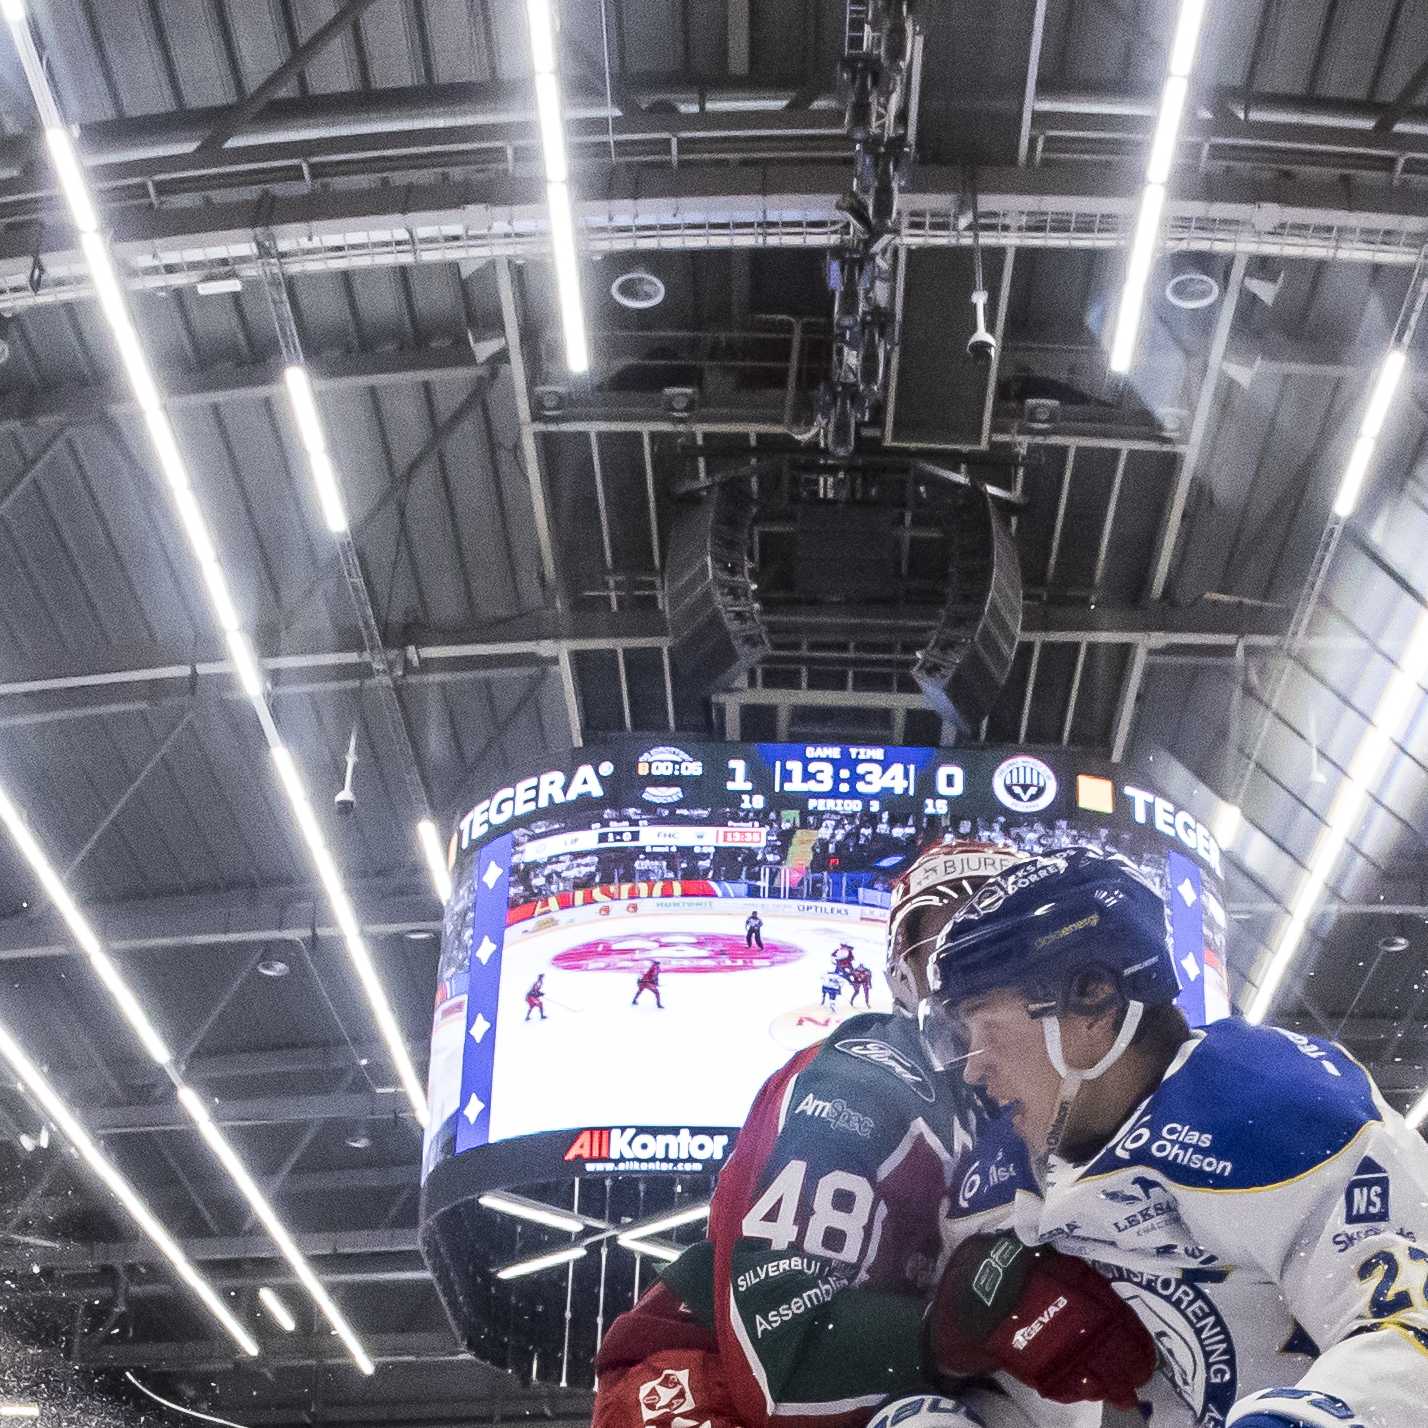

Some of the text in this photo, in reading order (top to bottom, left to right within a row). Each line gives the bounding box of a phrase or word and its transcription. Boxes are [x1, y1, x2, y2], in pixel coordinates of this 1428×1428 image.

[806, 746, 885, 760] GAME TIME
[726, 759, 753, 791] 1
[783, 760, 909, 795] 13:34
[936, 765, 965, 796] 0
[808, 799, 880, 812] PERIOD 3
[924, 798, 948, 814] 15
[564, 1127, 728, 1161] AllKontor
[1160, 1123, 1213, 1148] Clas
[585, 1161, 703, 1172] www.allkontor.com
[1150, 1140, 1233, 1177] Ohlson
[742, 1159, 875, 1264] 48
[1353, 1185, 1383, 1216] NS
